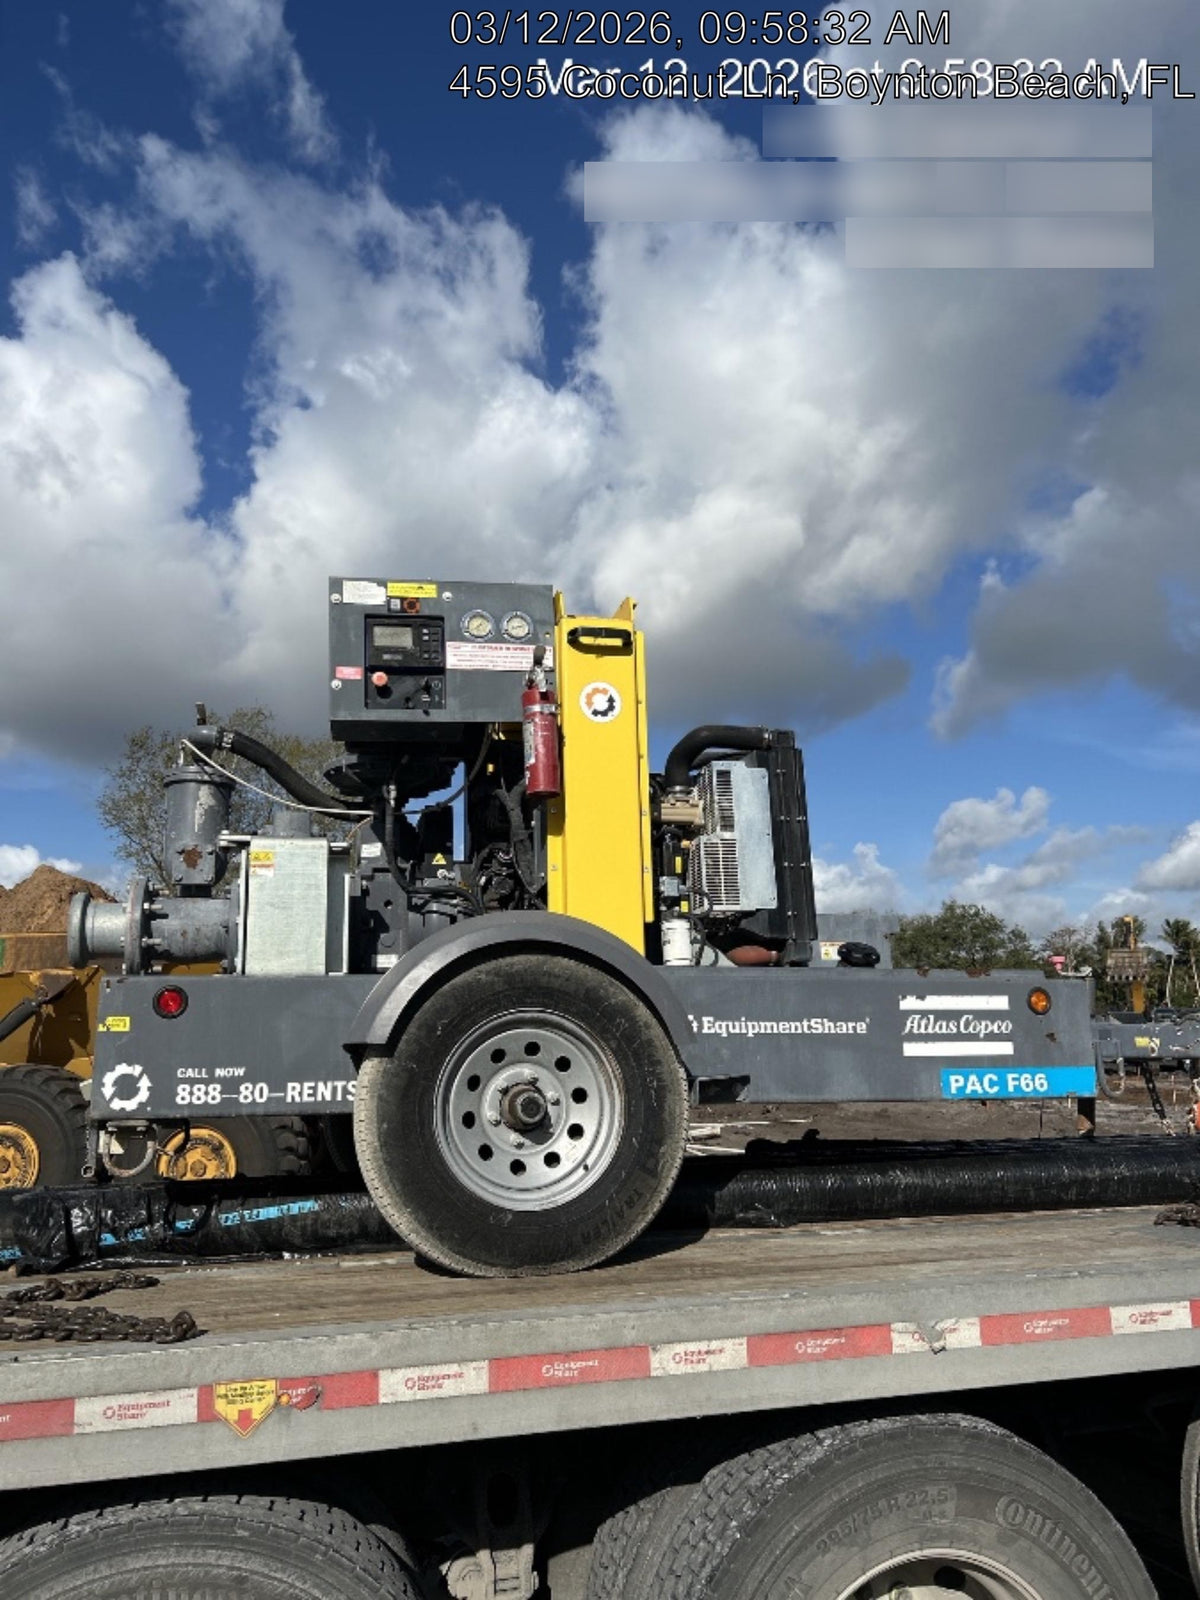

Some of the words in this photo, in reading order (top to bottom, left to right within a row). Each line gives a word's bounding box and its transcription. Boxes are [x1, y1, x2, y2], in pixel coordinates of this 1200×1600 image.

[702, 1016, 867, 1037] EquipmentShare
[902, 1015, 957, 1035] Atlas
[959, 1014, 1013, 1038] Copco
[176, 1067, 209, 1079] CALL
[214, 1066, 247, 1078] NOW
[950, 1073, 998, 1094] PAC
[1006, 1073, 1049, 1093] F66
